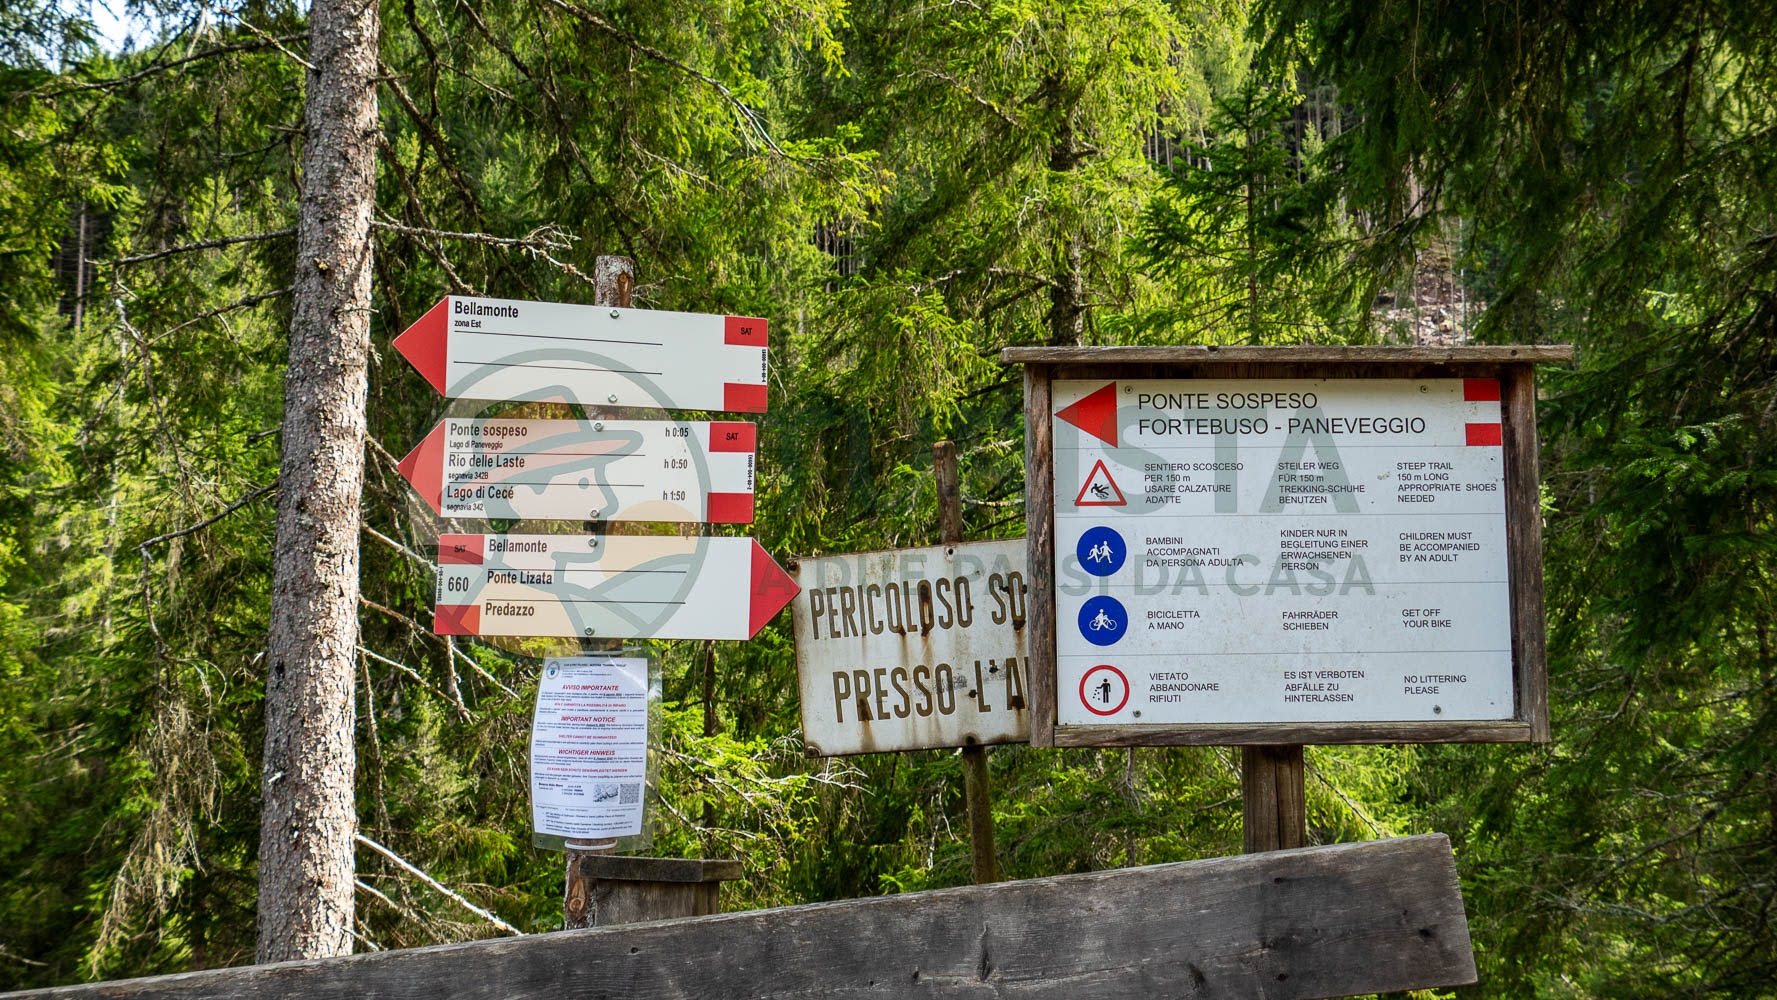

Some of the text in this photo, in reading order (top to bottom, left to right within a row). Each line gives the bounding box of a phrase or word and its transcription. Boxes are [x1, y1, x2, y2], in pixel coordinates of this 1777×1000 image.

[454, 301, 519, 318] Bellamonte
[470, 320, 482, 328] Est
[740, 327, 752, 335] SAT
[1138, 393, 1317, 410] PONTE SOSPESO
[1139, 418, 1269, 435] FORTEBUSO
[1288, 417, 1426, 434] PANEVEGGIO
[450, 423, 528, 439] Ponte sospeso
[665, 427, 689, 437] h 0:05
[726, 432, 739, 441] SAT
[449, 441, 463, 449] Lago
[471, 441, 503, 450] Paneveggio
[448, 454, 525, 468] Rio delle Laste
[664, 459, 688, 469] h 0:50
[1144, 463, 1244, 471] SENTIERO SCOSCESO
[1278, 462, 1340, 470] STEILER WEG
[1397, 462, 1453, 470] STEEP TRAIL
[448, 472, 489, 481] segnavia 342B
[1144, 474, 1163, 482] PER
[1165, 474, 1181, 482] 150
[1278, 473, 1297, 482] FÜR
[1300, 474, 1314, 482] 150
[1397, 473, 1412, 481] 150
[1423, 473, 1449, 481] LONG
[1144, 485, 1232, 493] USARE CALZATURE
[1279, 484, 1365, 493] TREKKING-SCHUHE
[1398, 483, 1497, 492] APPROPRIATE SHOES
[447, 484, 514, 501] Lago di Cecé
[663, 491, 686, 501] h 1:50
[1145, 496, 1181, 504] ADATTE
[1279, 495, 1327, 504] BENUTZEN
[1398, 494, 1435, 503] NEEDED
[446, 503, 484, 512] segnavia 342
[1280, 529, 1348, 538] KINDER NUR IN
[1399, 532, 1472, 541] CHILDREN MUST
[1146, 537, 1183, 545] BAMBINI
[1281, 540, 1368, 549] BEGLEITUNG EINER
[489, 539, 547, 553] Bellamonte
[1400, 543, 1480, 552] BE ACCOMPANIED
[1147, 547, 1220, 556] ACCOMPAGNATI
[1281, 551, 1352, 560] ERWACHSENEN
[1146, 558, 1244, 567] DA PERSONA ADULTA
[1400, 554, 1459, 562] BY AN ADULT
[1281, 562, 1320, 571] PERSON
[487, 570, 553, 585] Ponte Lizata
[448, 577, 469, 592] 660
[485, 602, 535, 617] Predazzo
[809, 576, 973, 641] PERICOLOSO
[1402, 608, 1441, 617] GET OFF
[1147, 610, 1200, 619] BICICLETTA
[1282, 610, 1338, 619] FAHRRÄDER
[1148, 621, 1185, 630] A MANO
[1283, 622, 1329, 631] SCHIEBEN
[1402, 619, 1452, 628] YOUR BIKE
[1149, 672, 1189, 681] VIETATO
[1284, 670, 1365, 680] ES IST VERBOTEN
[1404, 675, 1467, 684] NO LITTERING
[1149, 683, 1220, 692] ABBANDONARE
[1284, 682, 1340, 692] ABFÄLLE ZU
[1404, 686, 1440, 695] PLEASE
[832, 663, 956, 723] PRESSO
[1149, 695, 1181, 703] RIFIUTI
[1284, 694, 1354, 703] HINTERLASSEN
